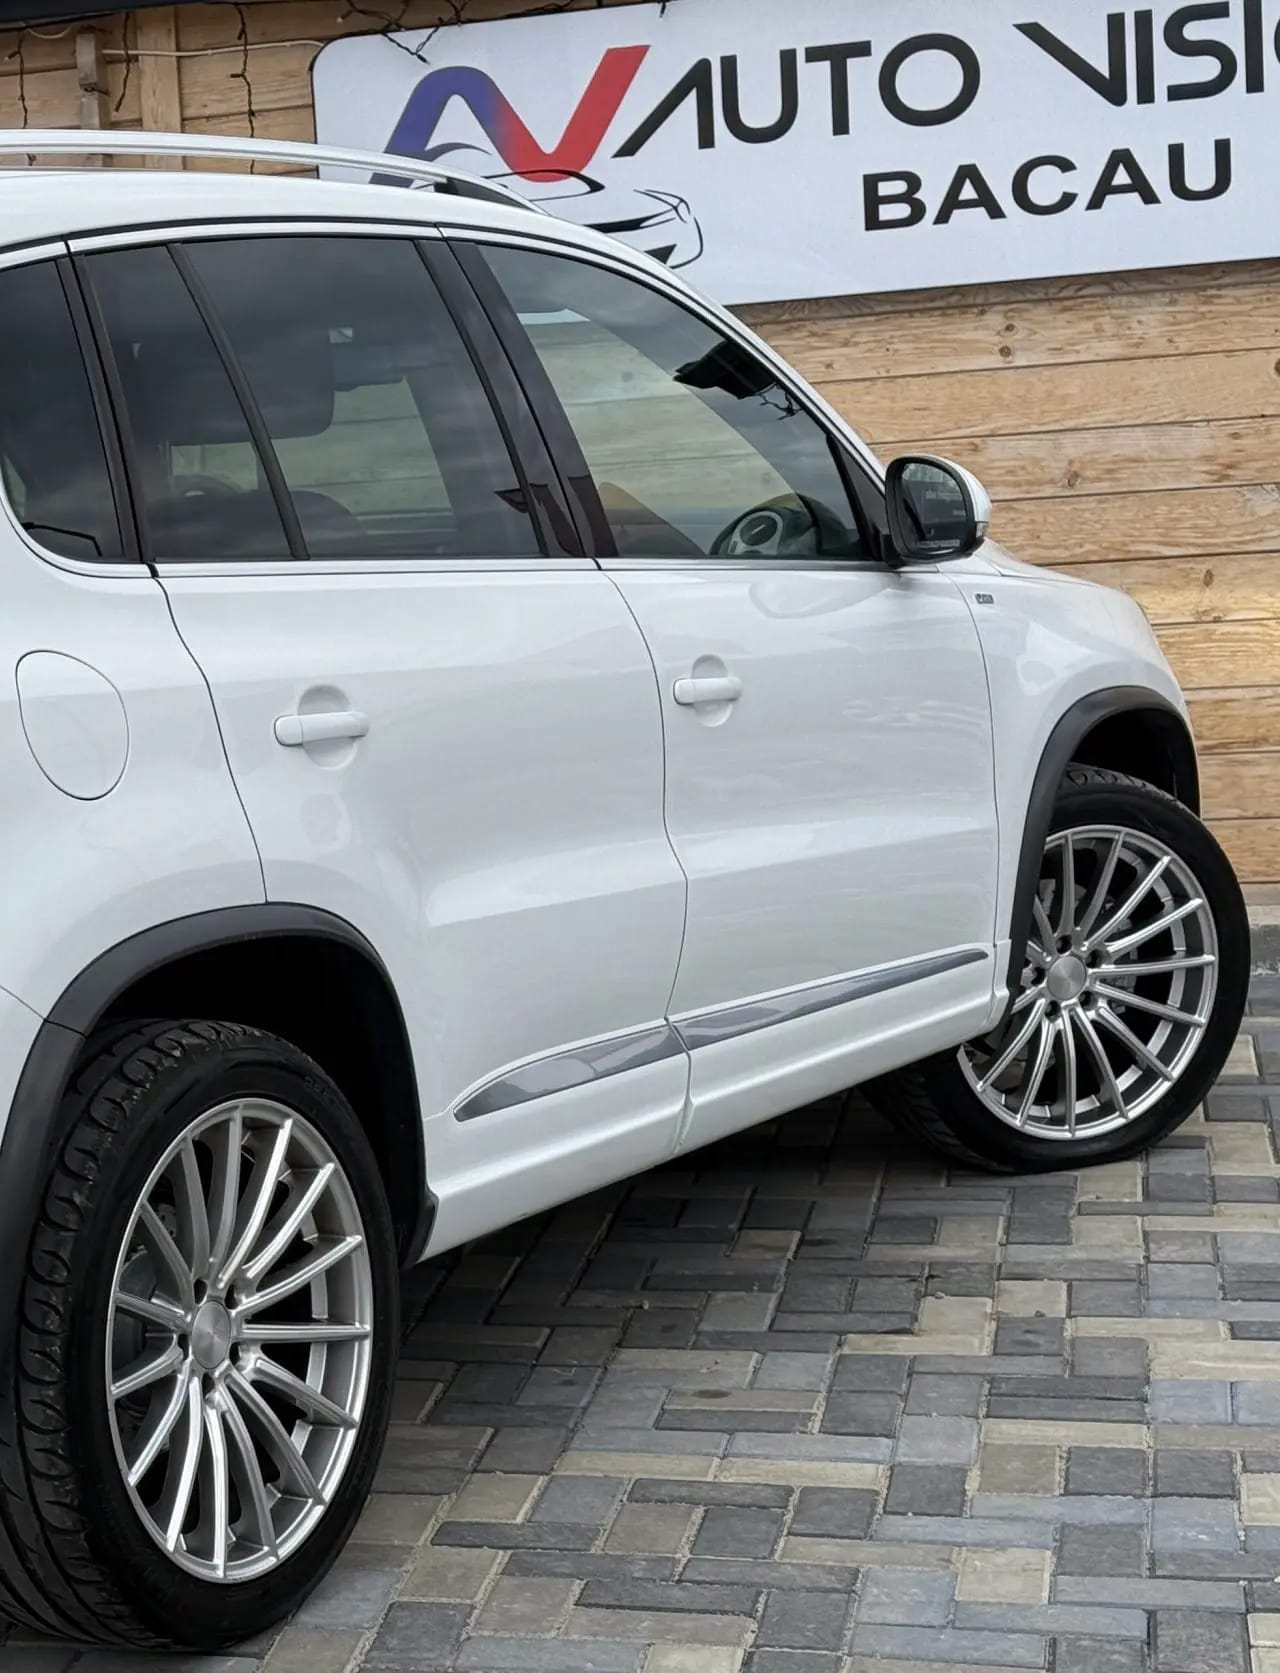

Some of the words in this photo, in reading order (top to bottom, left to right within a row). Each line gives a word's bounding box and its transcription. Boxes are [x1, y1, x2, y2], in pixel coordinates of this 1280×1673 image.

[612, 33, 981, 159] AUTO
[1013, 0, 1280, 107] VISI
[863, 138, 1232, 232] BACAU
